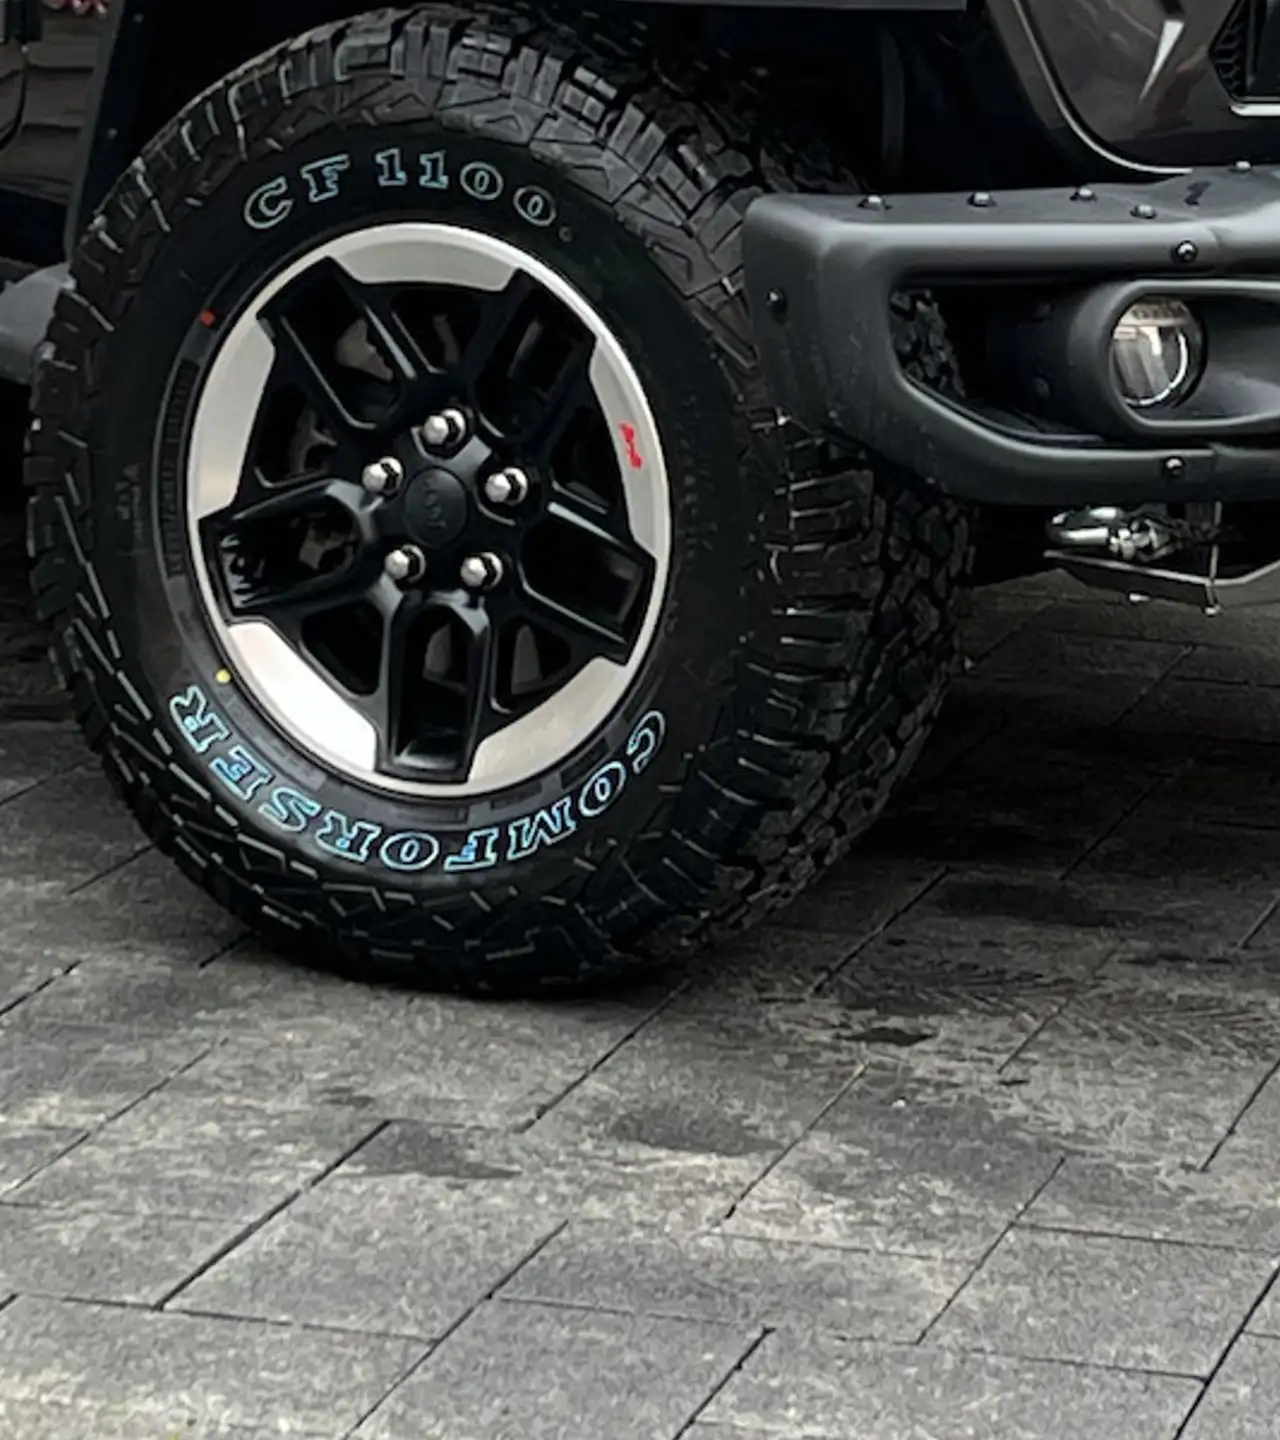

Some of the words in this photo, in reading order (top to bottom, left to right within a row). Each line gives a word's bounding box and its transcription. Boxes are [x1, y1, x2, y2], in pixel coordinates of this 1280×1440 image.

[243, 153, 351, 230] CF
[376, 147, 558, 228] 1100
[168, 684, 666, 874] COMFORSER
